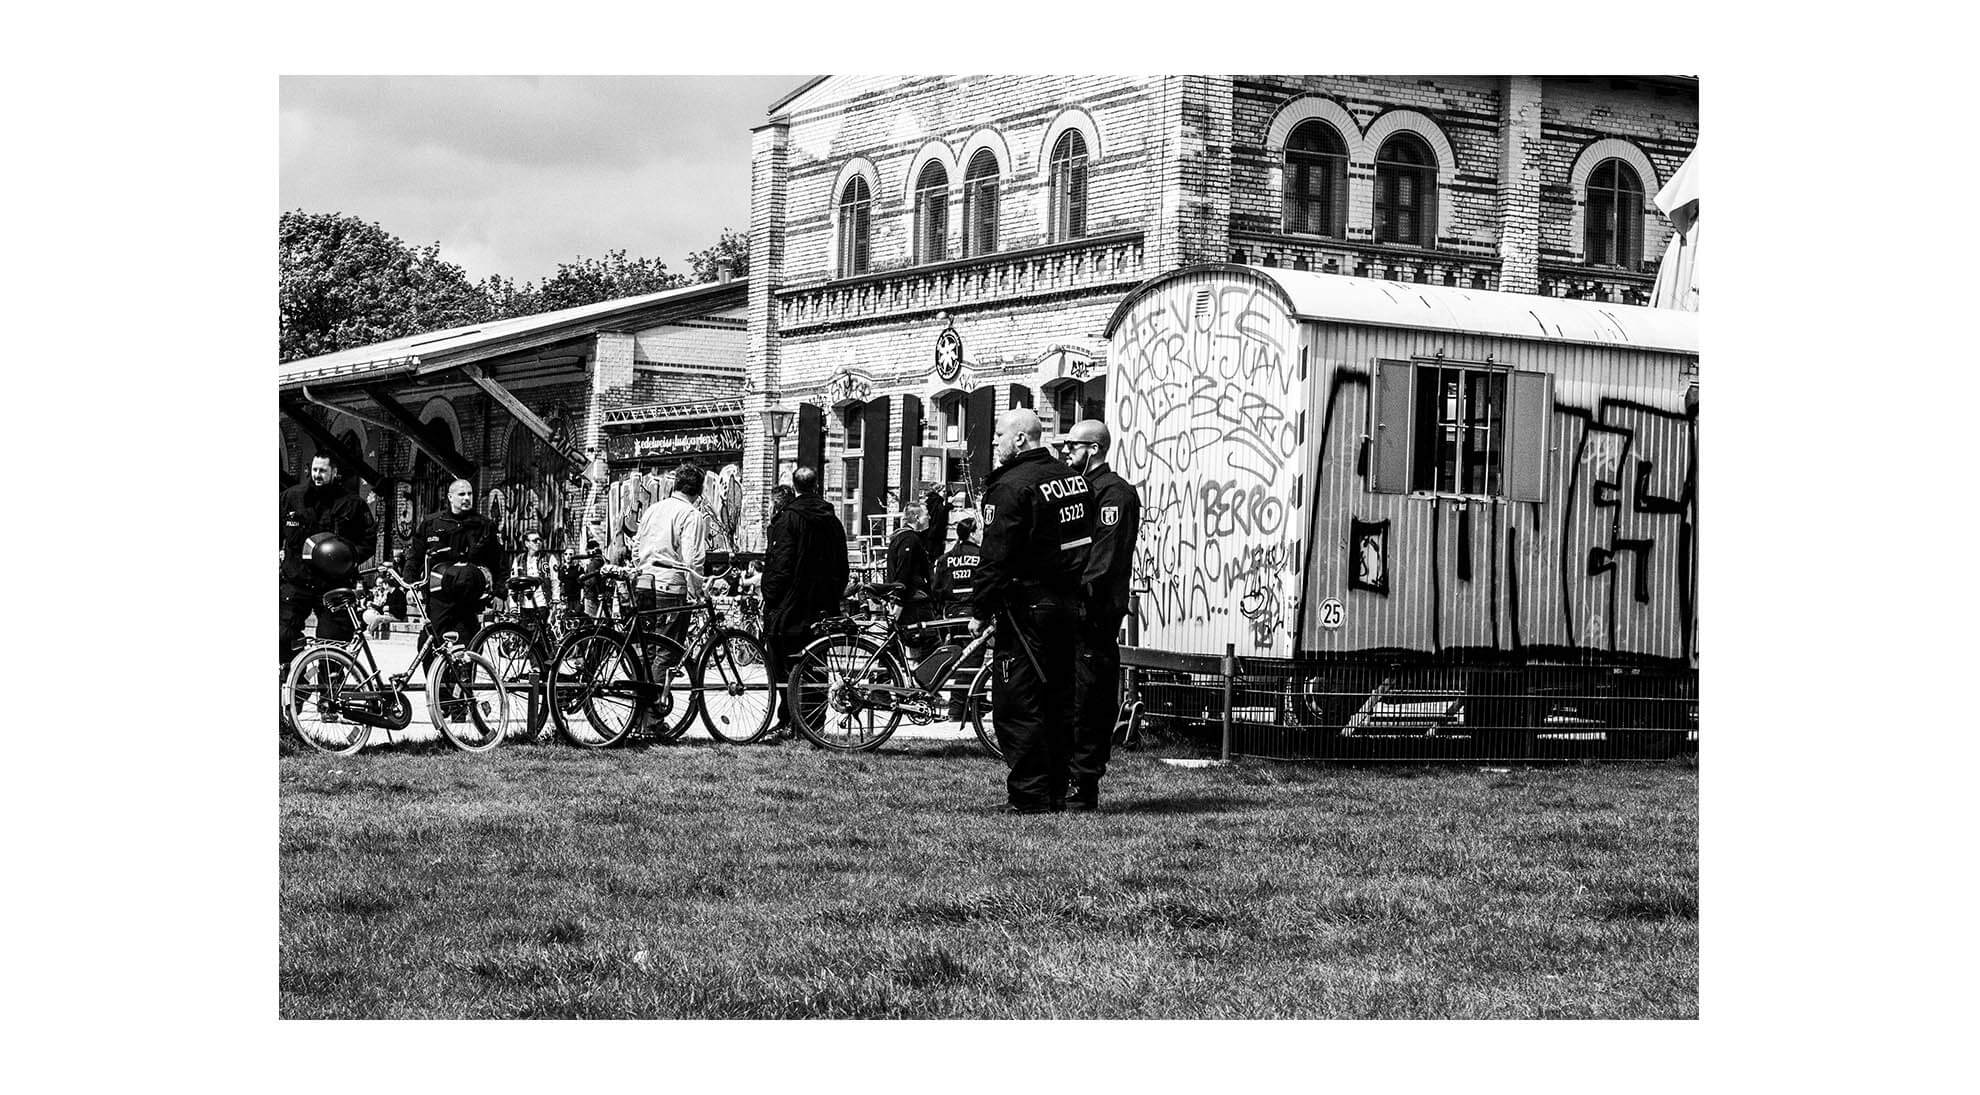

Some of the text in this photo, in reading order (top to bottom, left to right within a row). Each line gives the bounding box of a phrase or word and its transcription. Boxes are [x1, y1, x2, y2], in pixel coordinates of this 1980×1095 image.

[1039, 475, 1089, 502] POLIZEI
[1059, 502, 1085, 524] 15223
[1200, 479, 1283, 537] BERRO
[947, 555, 981, 568] POLIZEI
[1323, 603, 1341, 624] 25
